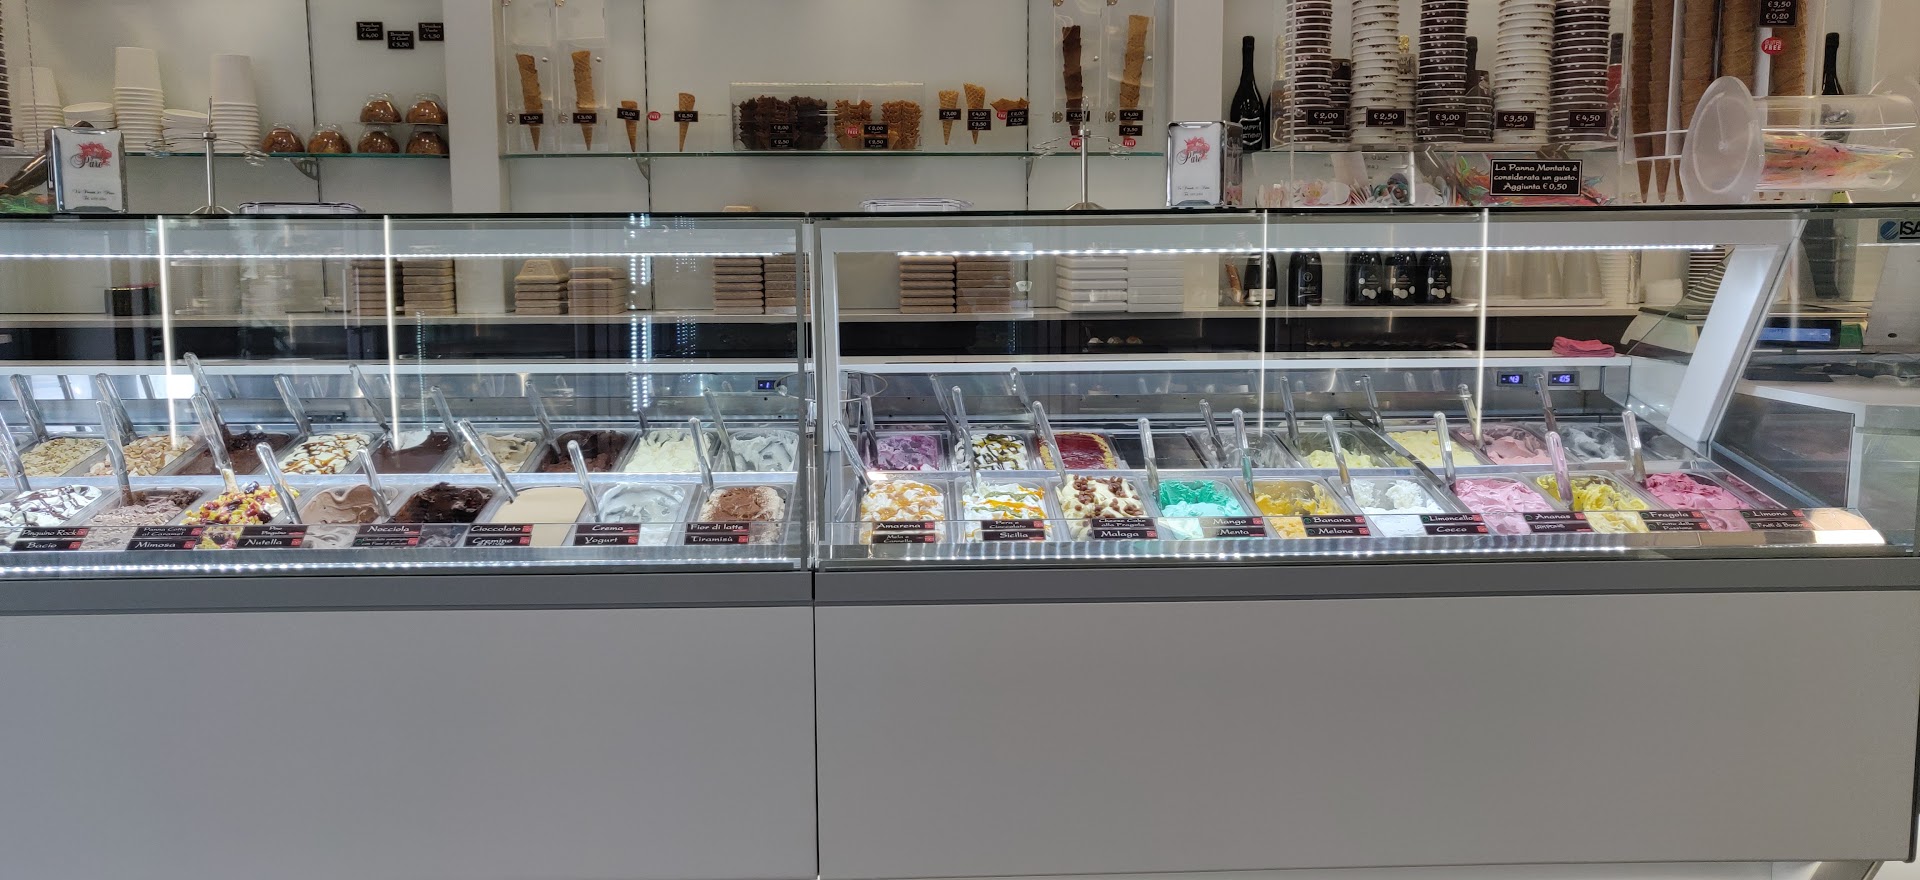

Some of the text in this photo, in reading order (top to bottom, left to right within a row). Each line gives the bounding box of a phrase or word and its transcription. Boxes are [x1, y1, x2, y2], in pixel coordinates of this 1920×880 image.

[1502, 182, 1540, 191] Aggiunta
[22, 529, 55, 537] Pinguino
[999, 531, 1029, 539] Sicilia
[244, 538, 283, 546] Nutella
[584, 536, 618, 545] Yogurt
[691, 535, 733, 543] Tiramisù
[134, 541, 176, 549] Mimosa
